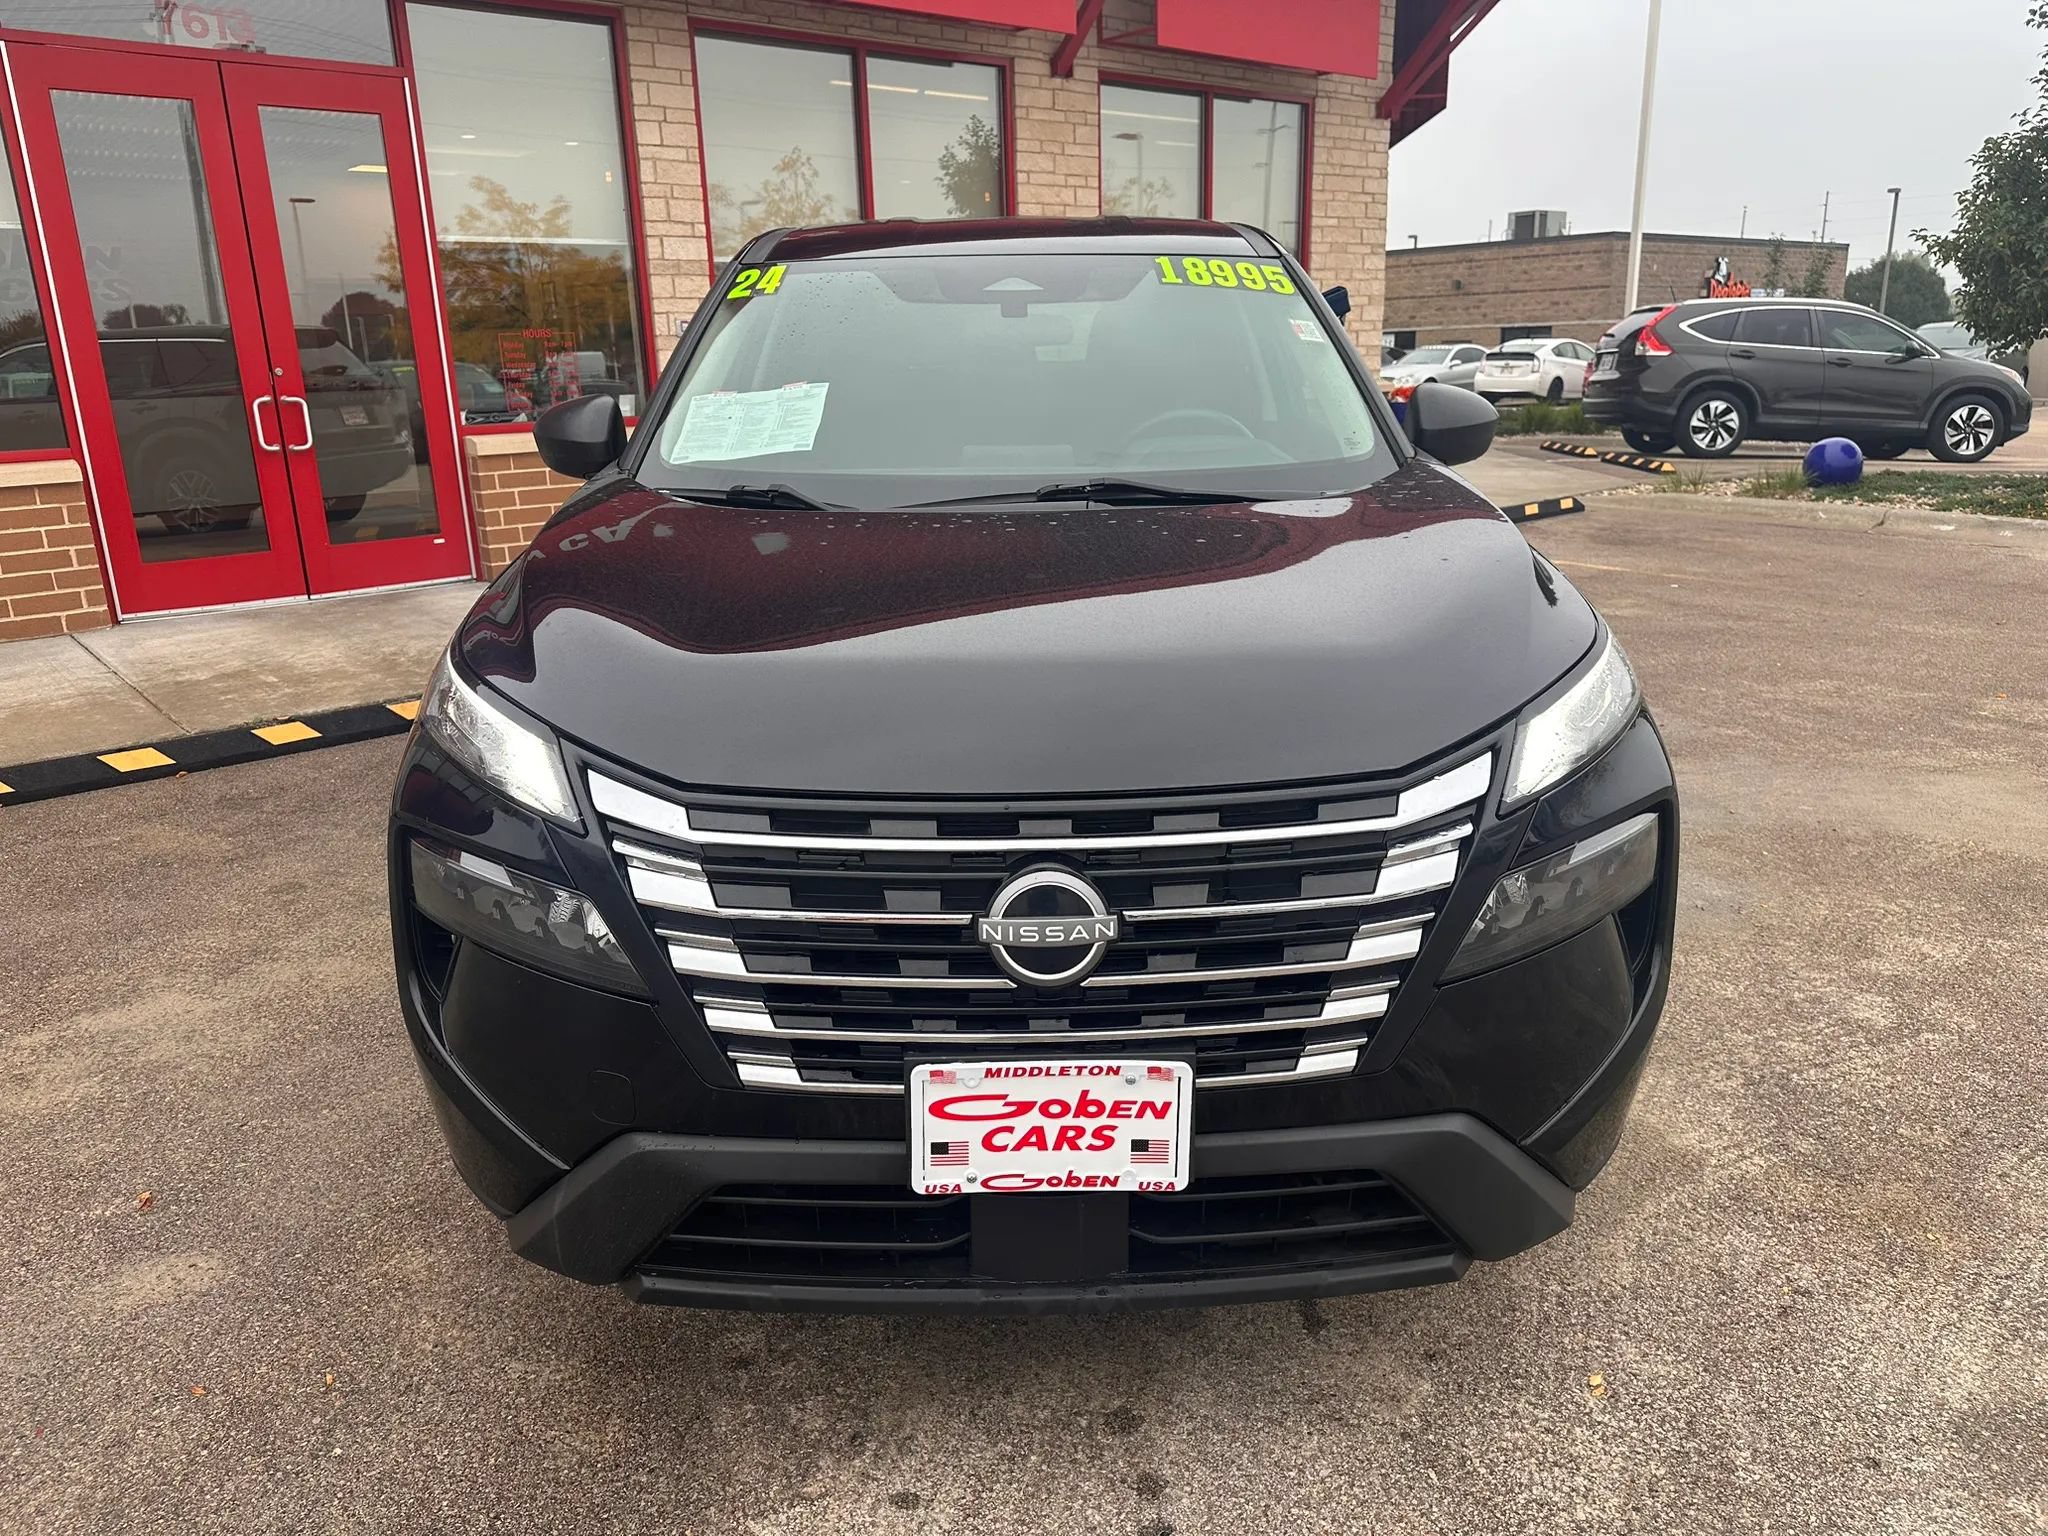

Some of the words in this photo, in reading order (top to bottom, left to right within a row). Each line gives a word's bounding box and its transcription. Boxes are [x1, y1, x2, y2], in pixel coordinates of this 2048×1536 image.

[727, 265, 787, 299] 24
[1155, 256, 1295, 295] 18995
[523, 329, 552, 338] HOURS
[982, 921, 1114, 942] NISSAN
[984, 1065, 1122, 1080] MIDDLETON
[981, 1125, 1119, 1152] CARS
[925, 1183, 962, 1194] USA
[1138, 1181, 1176, 1192] USA
